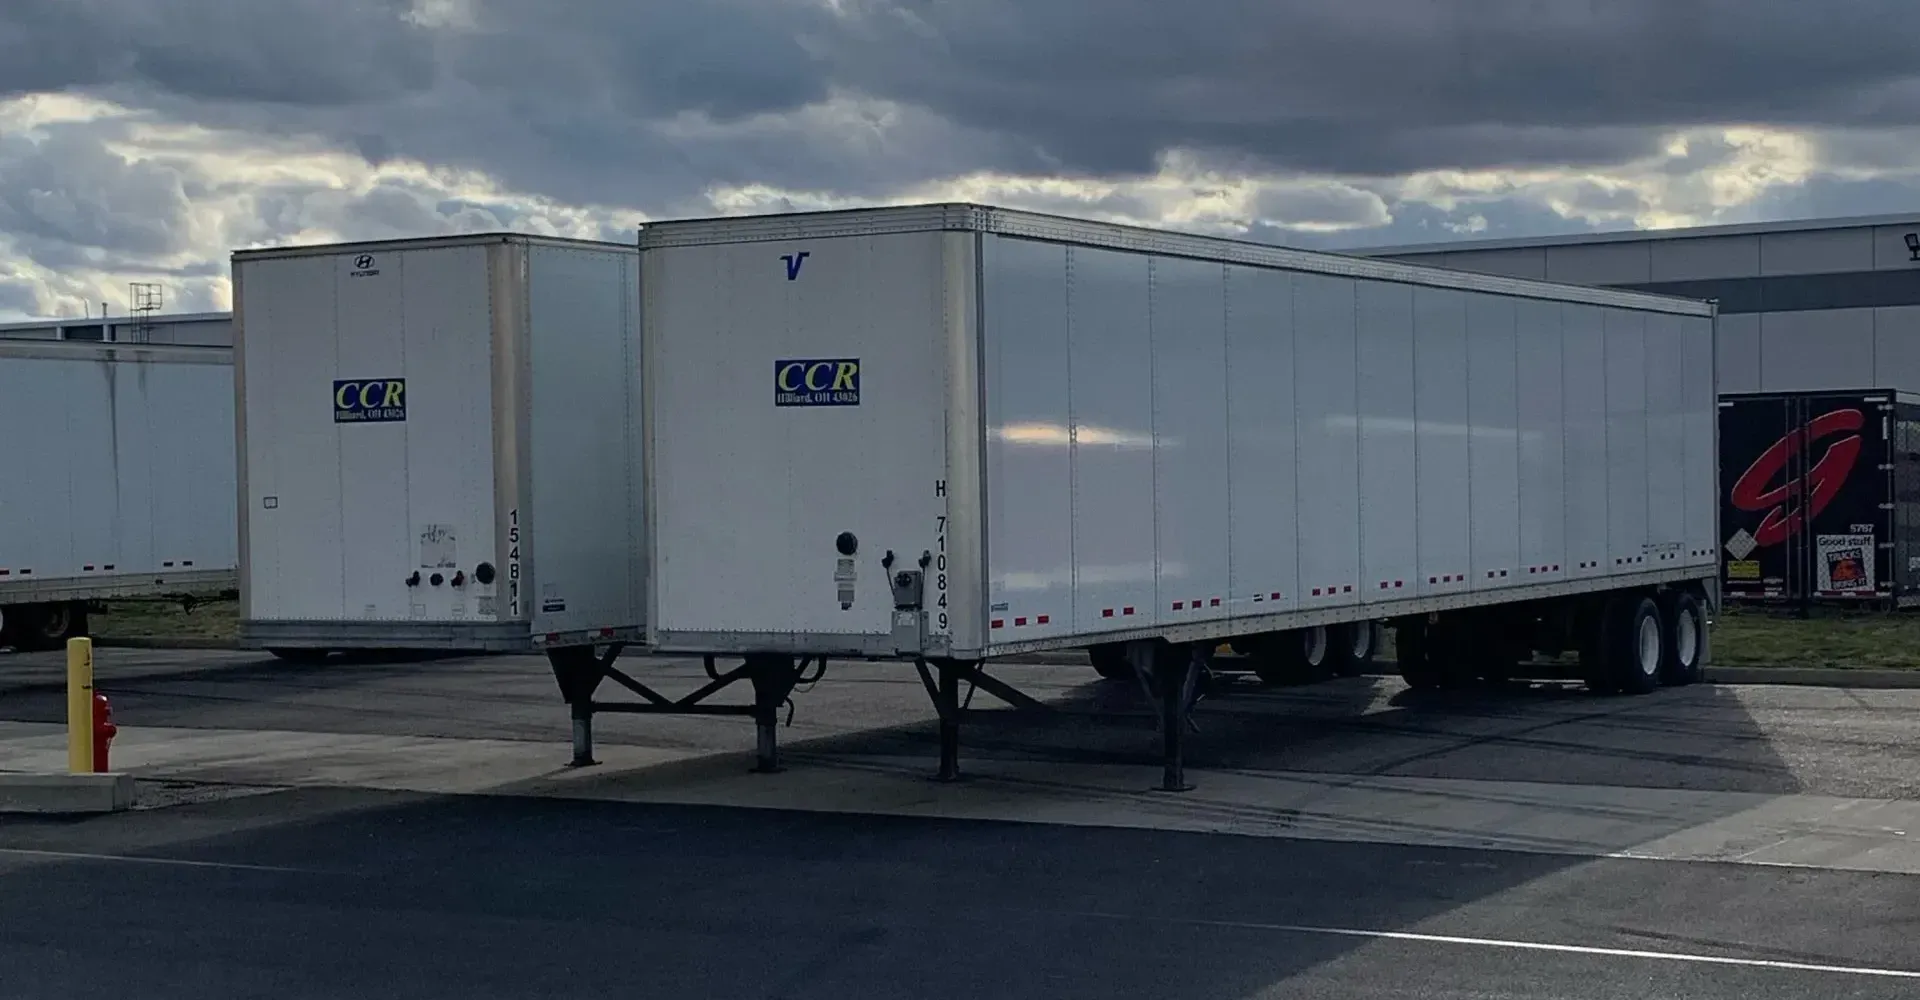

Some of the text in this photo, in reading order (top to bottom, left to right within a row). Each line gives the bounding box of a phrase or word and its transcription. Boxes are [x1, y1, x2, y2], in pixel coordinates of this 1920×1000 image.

[778, 362, 857, 391] CCR
[336, 381, 403, 408] CCR
[815, 392, 830, 402] OH
[936, 480, 947, 629] H 710849
[1820, 537, 1846, 546] Good
[509, 509, 520, 615] 154811
